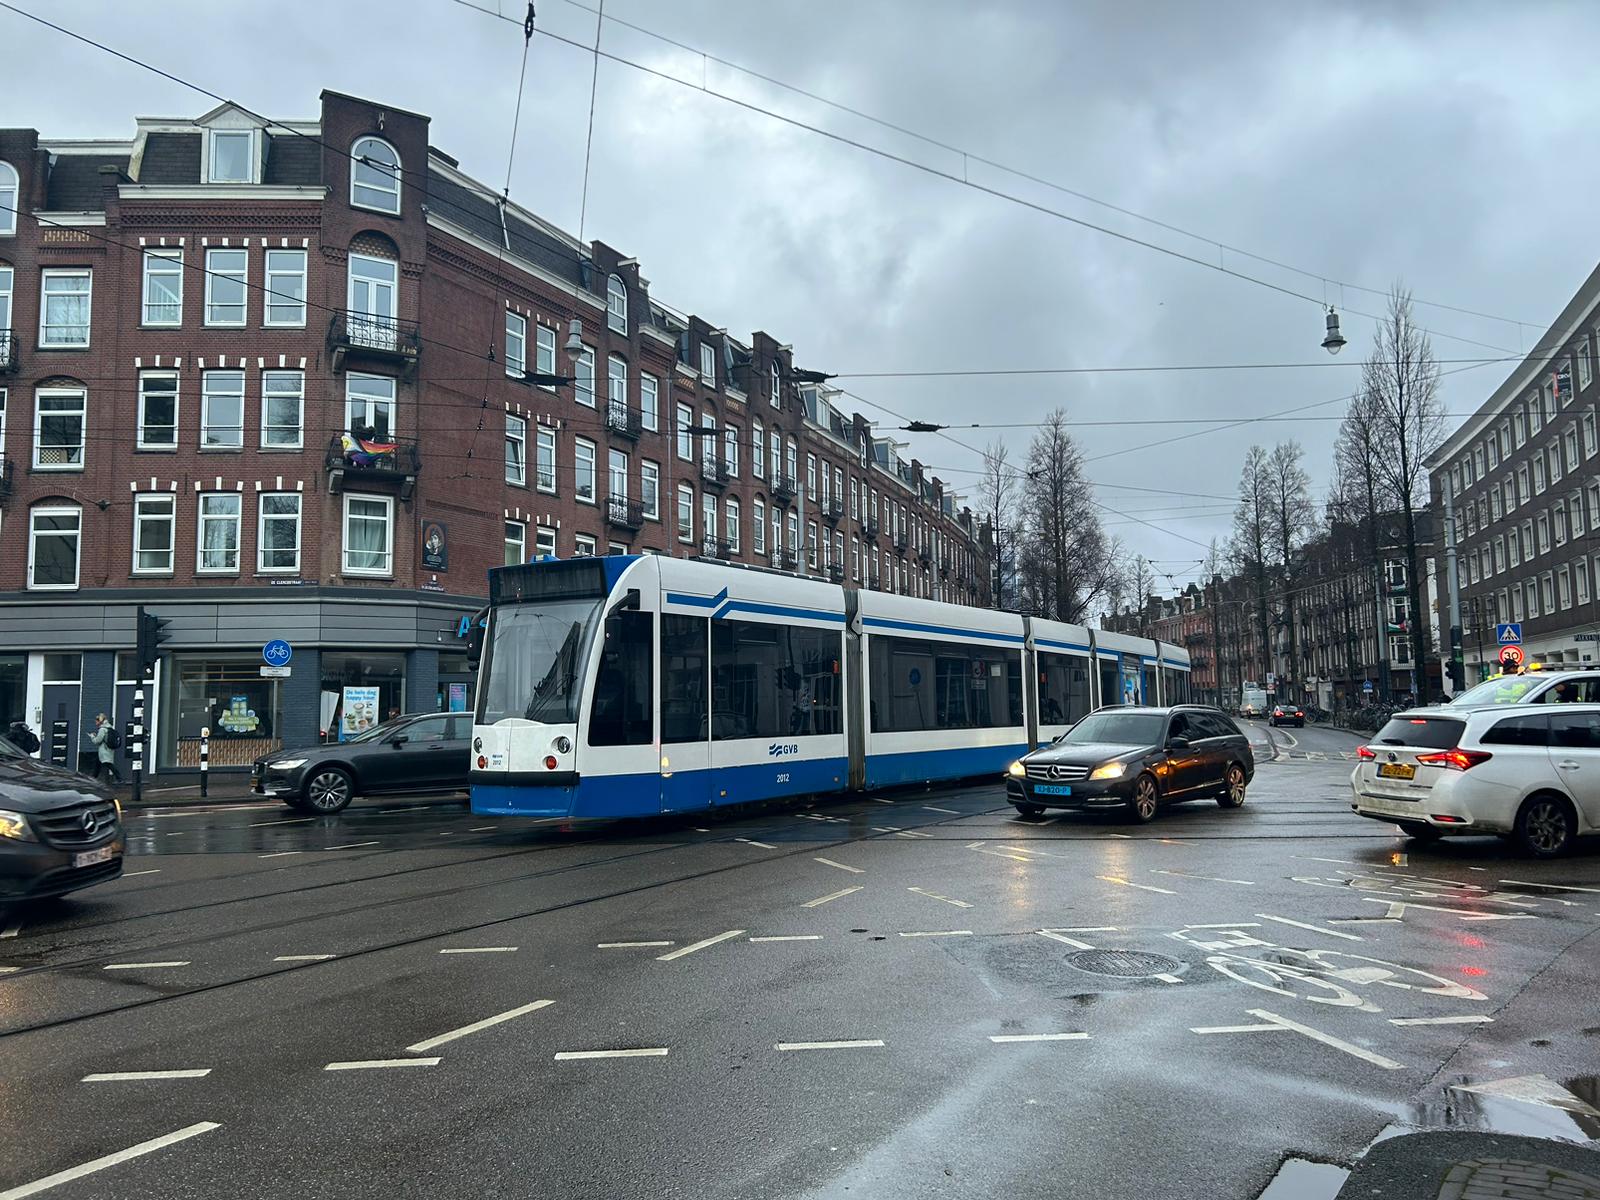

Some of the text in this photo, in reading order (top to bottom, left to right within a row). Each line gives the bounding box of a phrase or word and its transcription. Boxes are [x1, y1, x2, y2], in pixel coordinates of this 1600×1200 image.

[1504, 651, 1519, 660] 30
[783, 744, 798, 754] GVB
[776, 773, 790, 783] 2012
